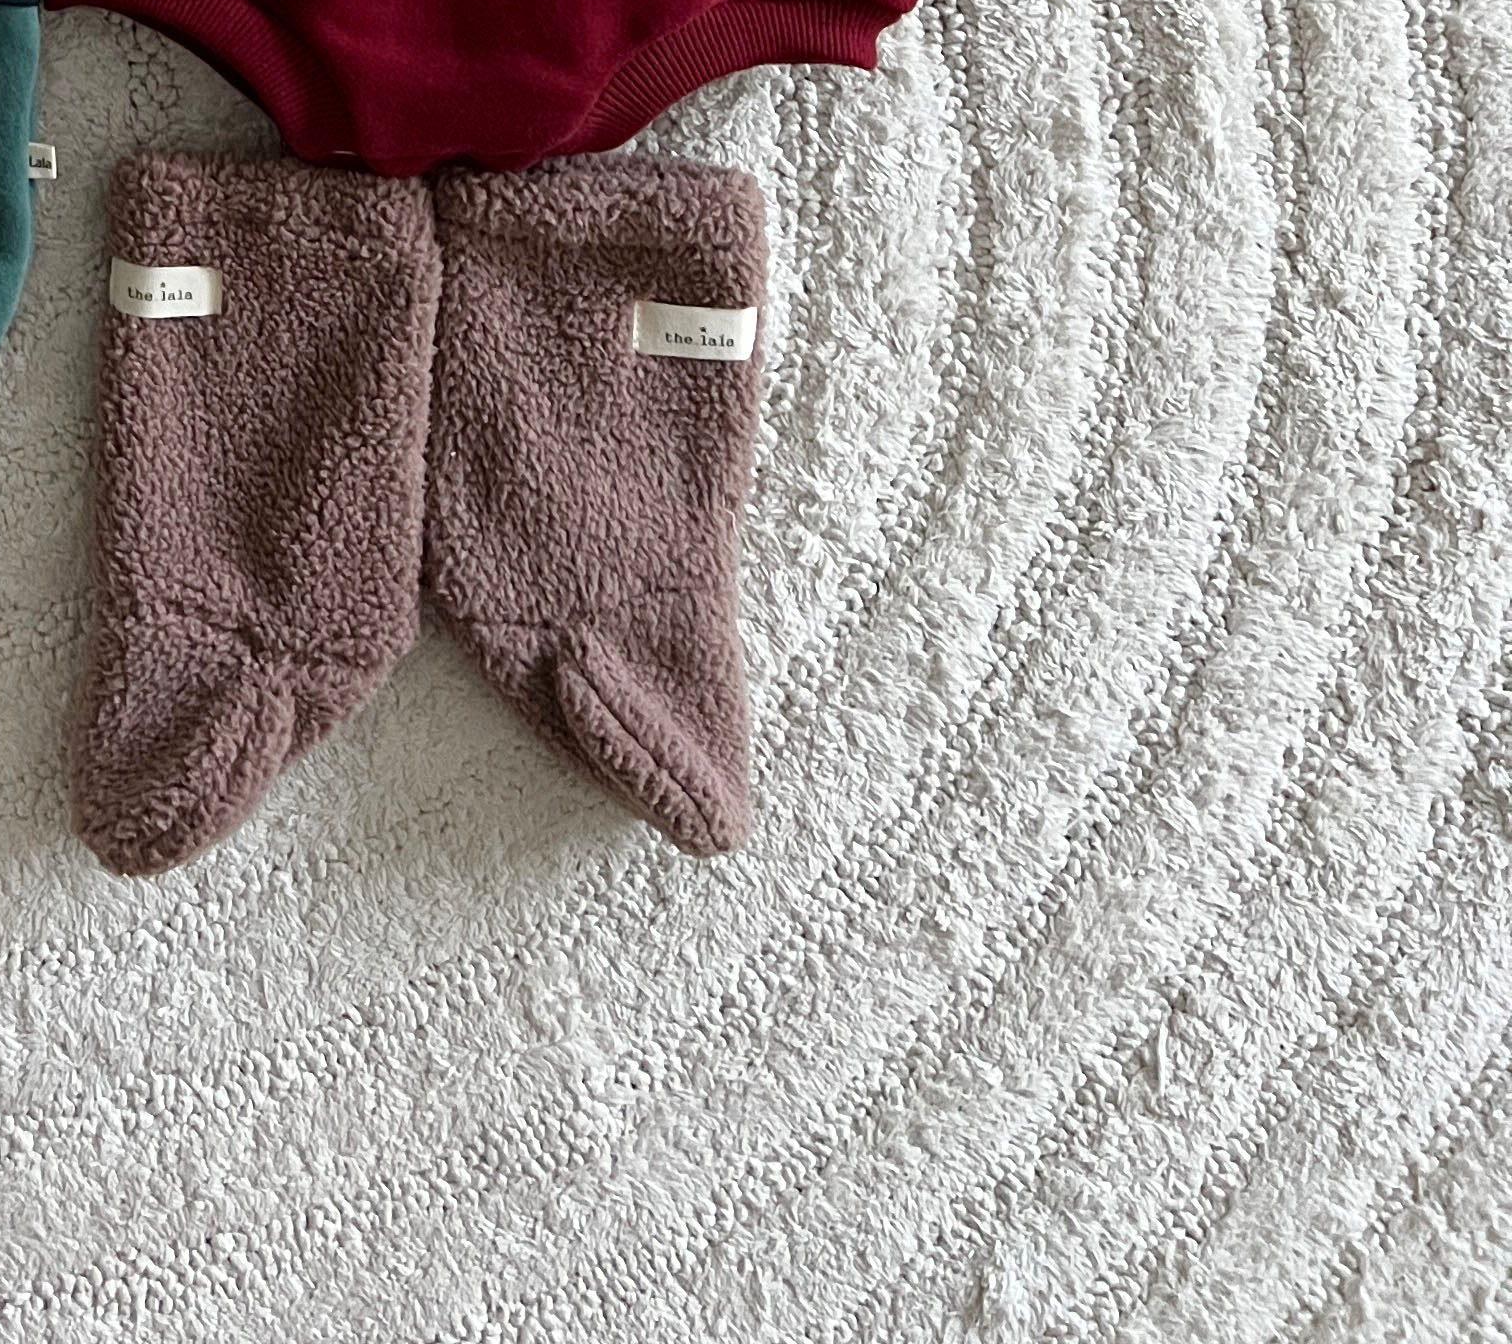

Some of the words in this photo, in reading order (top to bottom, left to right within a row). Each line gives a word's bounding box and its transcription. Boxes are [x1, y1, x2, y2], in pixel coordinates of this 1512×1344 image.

[28, 155, 52, 169] Lala
[127, 286, 153, 302] the
[665, 332, 693, 345] the
